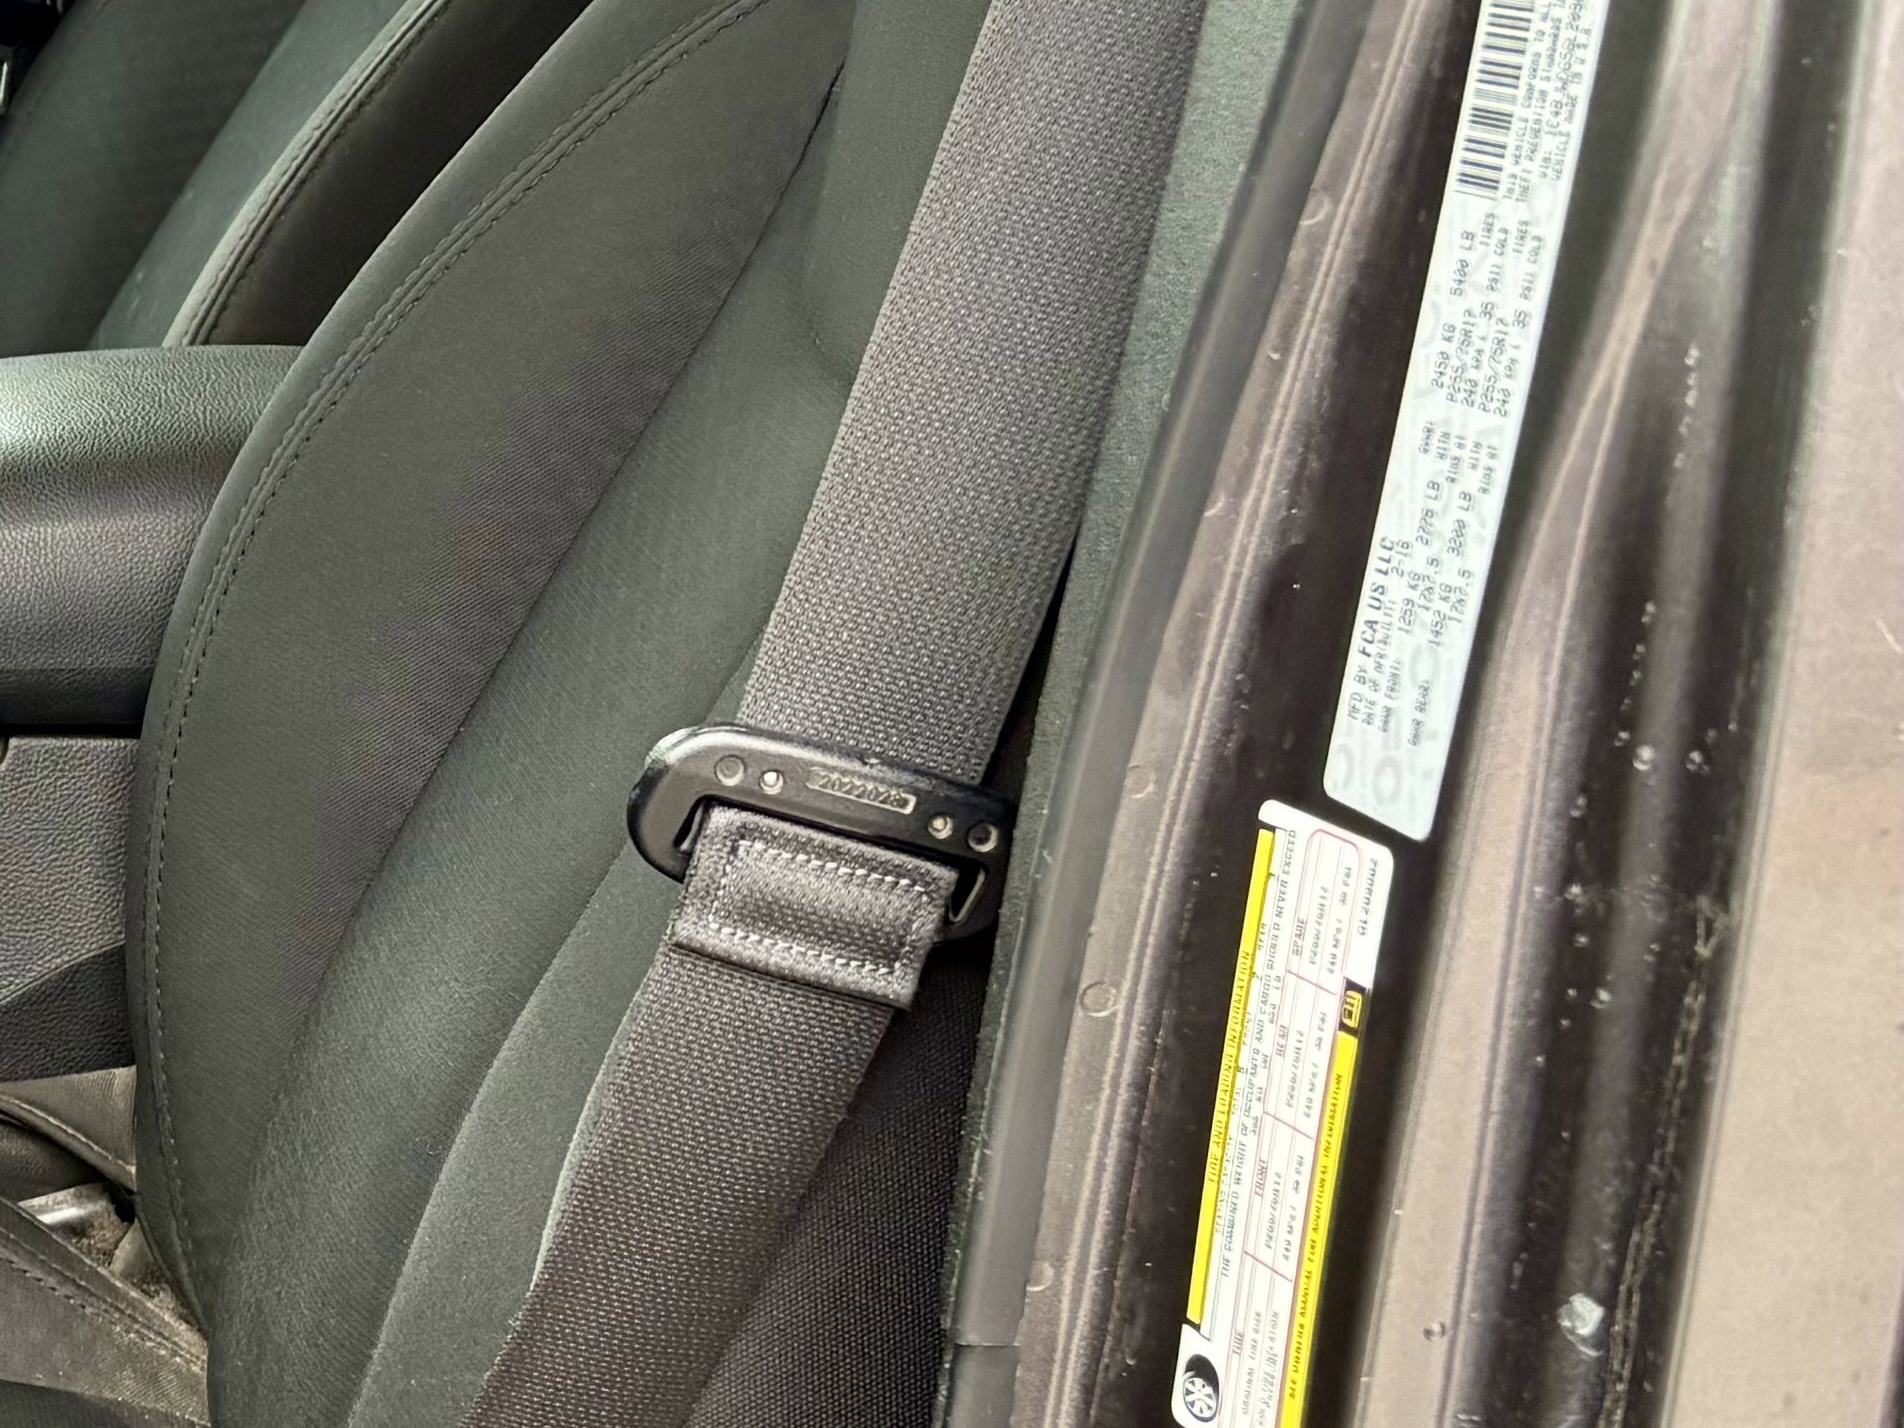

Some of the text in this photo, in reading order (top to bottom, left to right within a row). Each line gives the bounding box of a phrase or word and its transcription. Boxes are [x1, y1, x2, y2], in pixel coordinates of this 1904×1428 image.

[1537, 0, 1552, 23] ALL
[1533, 28, 1546, 43] TO
[1520, 50, 1542, 109] CONFORMS
[1509, 115, 1529, 166] VEHICLE
[1522, 87, 1548, 162] PREVENTION
[1550, 129, 1570, 182] VEHICLE
[1502, 171, 1518, 201] THIS
[1514, 167, 1533, 204] THEFT
[1458, 229, 1476, 251] LB
[1478, 210, 1497, 247] TIRES
[1511, 218, 1530, 255] TIRES
[1448, 257, 1470, 298] 5400
[1439, 321, 1457, 343] KG
[1460, 377, 1479, 408] 240
[1478, 299, 1495, 321] 35
[1493, 225, 1510, 257] COLD
[1430, 349, 1451, 389] 2450
[1492, 386, 1512, 418] 240
[1510, 307, 1528, 329] 35
[1424, 478, 1442, 501] LB
[1456, 489, 1474, 513] LB
[1446, 516, 1468, 557] 3200
[1389, 537, 1411, 578] 2-16
[1405, 569, 1422, 592] KG
[1435, 581, 1453, 604] KG
[1345, 534, 1395, 721] MFD BY FCA US LLC
[1396, 596, 1416, 635] 1259
[1426, 607, 1447, 648] 1452
[1367, 677, 1381, 693] OF
[1361, 697, 1377, 726] DATE
[1253, 1017, 1265, 1044] AND
[1281, 828, 1297, 876] EXCEED
[1212, 1118, 1224, 1149] AND
